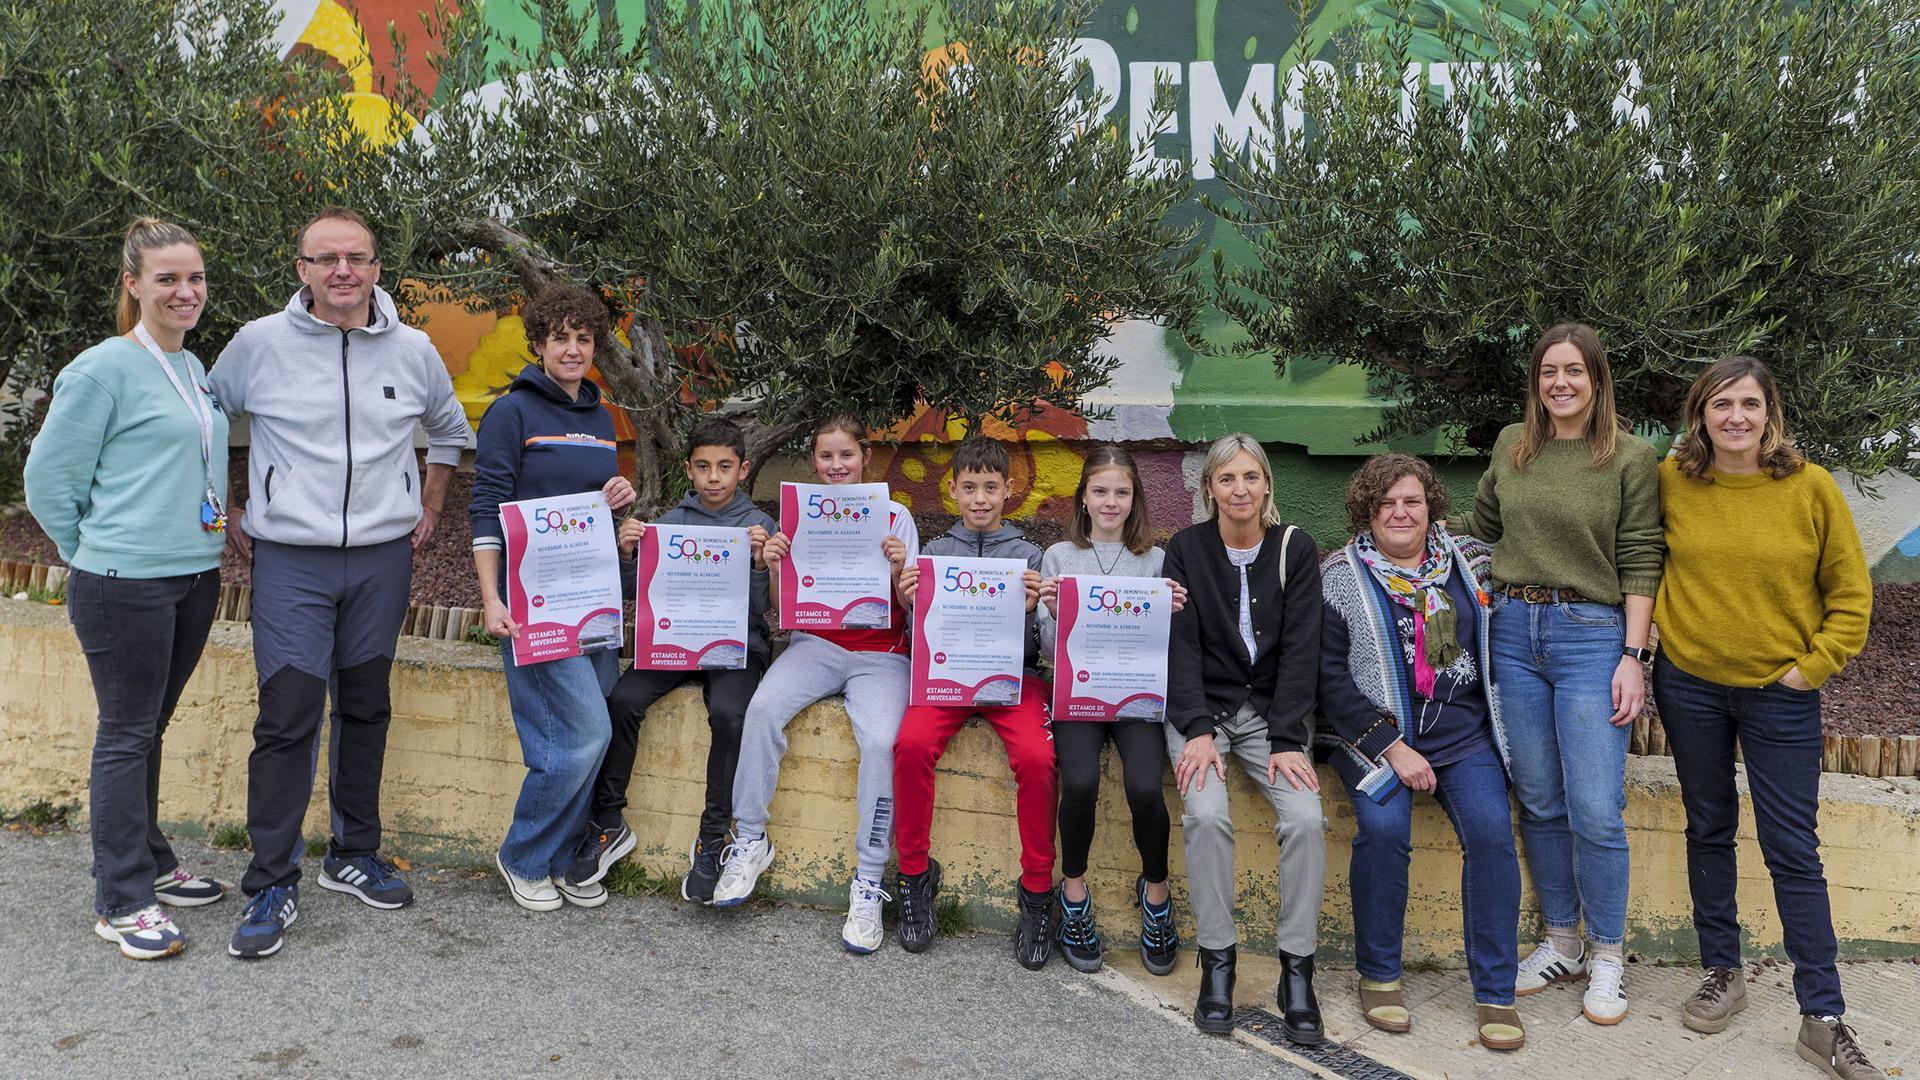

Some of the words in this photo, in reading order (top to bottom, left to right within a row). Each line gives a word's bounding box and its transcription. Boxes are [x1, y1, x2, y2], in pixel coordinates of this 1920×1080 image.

[807, 494, 837, 519] 50
[535, 507, 563, 534] 50
[667, 534, 697, 560] 50
[943, 566, 973, 592] 50
[1087, 586, 1118, 611] 50
[557, 628, 565, 636] DE
[868, 796, 893, 848] PUMA
